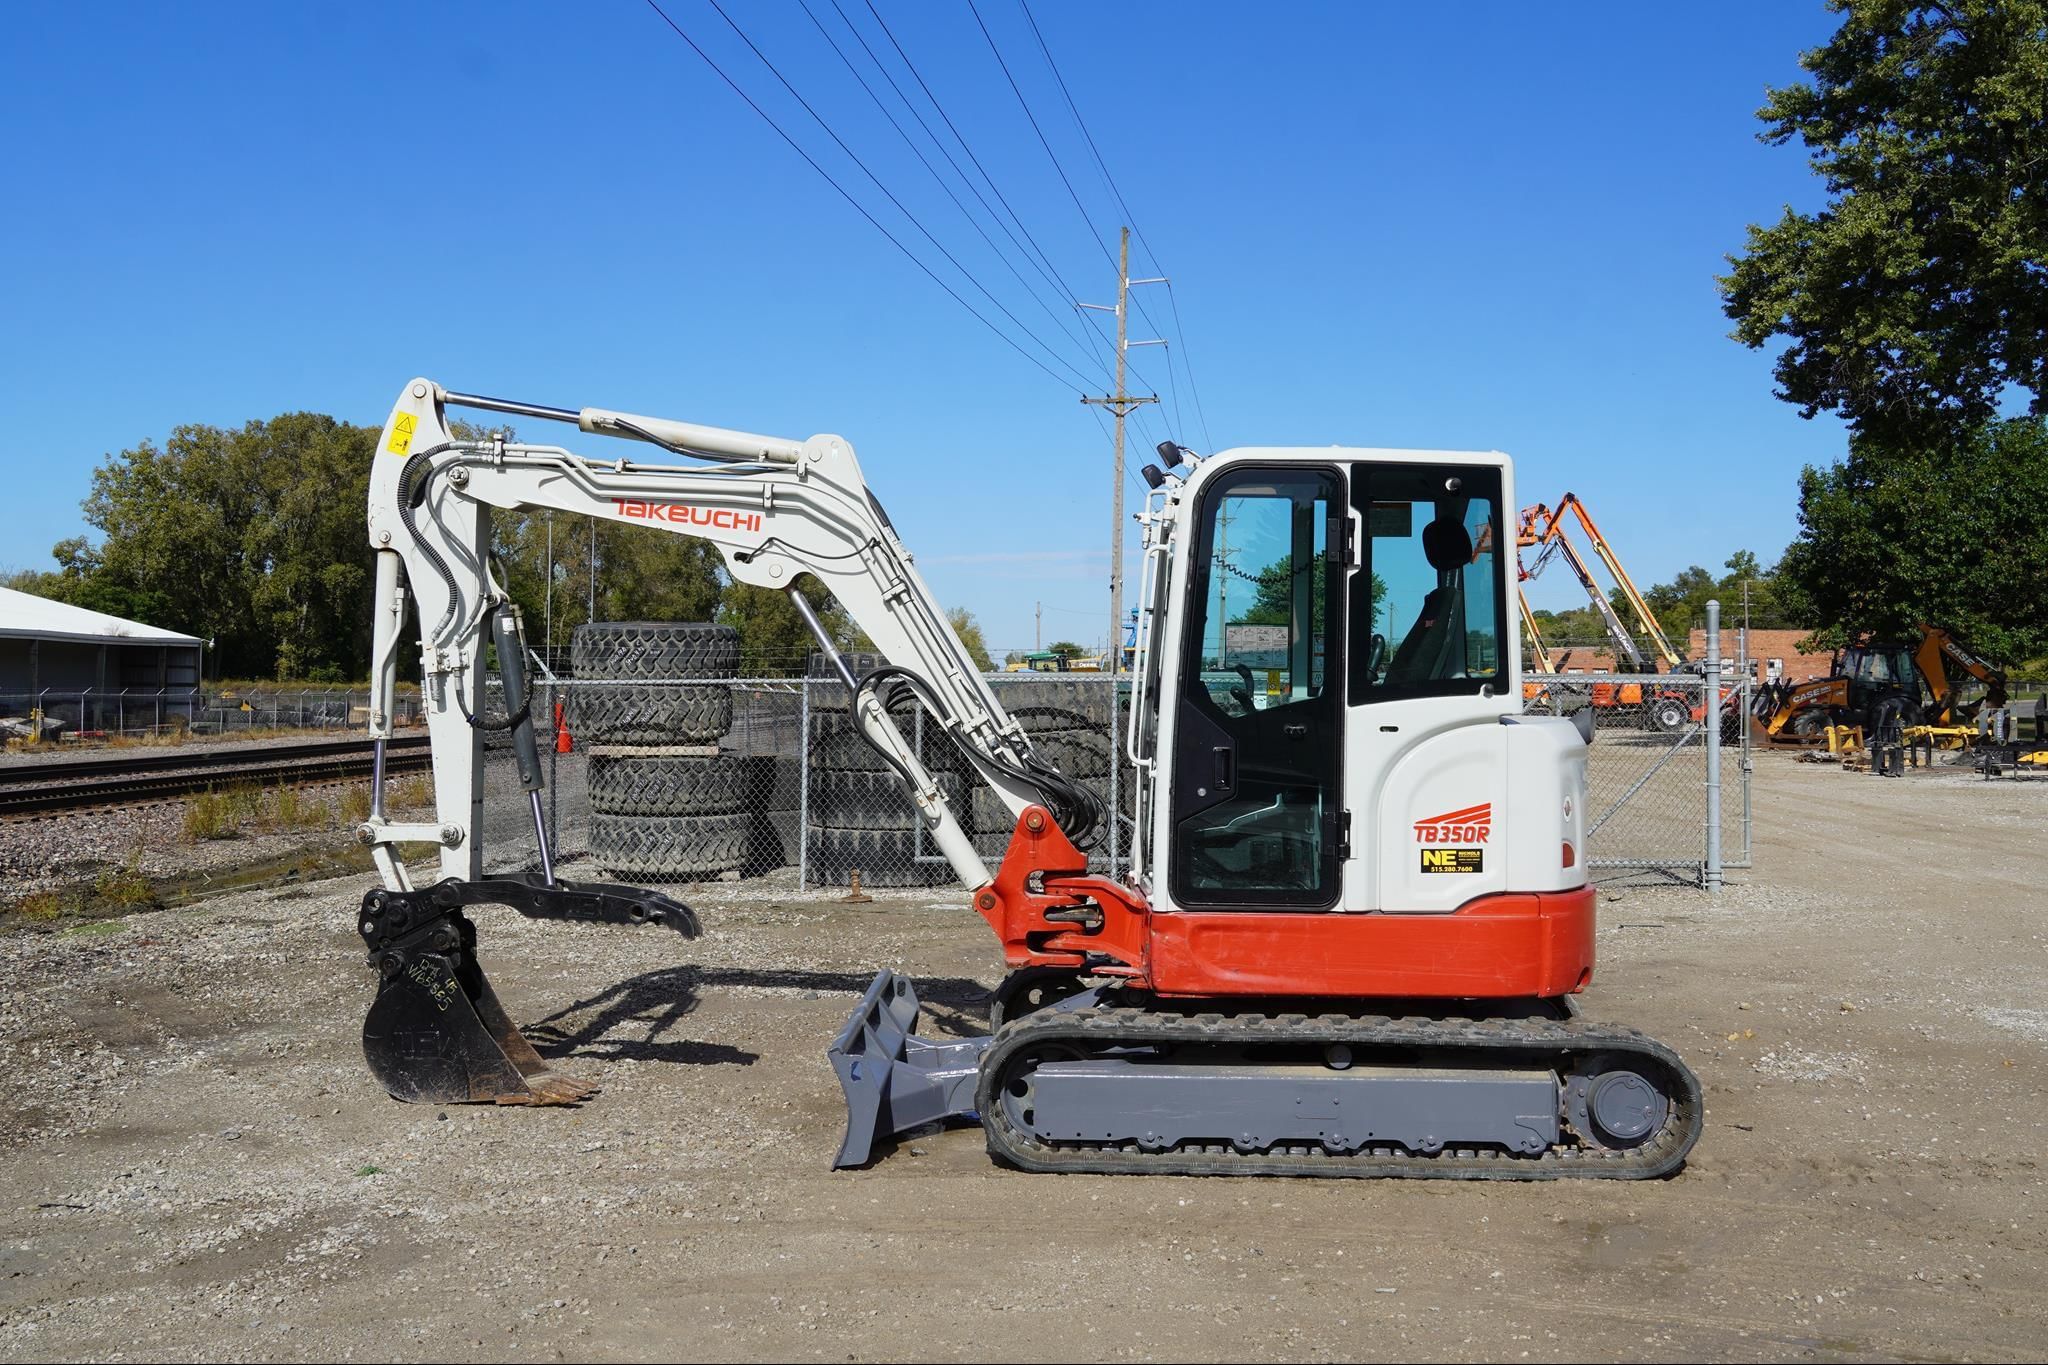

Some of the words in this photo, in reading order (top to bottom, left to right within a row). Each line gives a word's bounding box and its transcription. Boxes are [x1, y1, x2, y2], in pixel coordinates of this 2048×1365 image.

[1946, 642, 1975, 667] CASE
[1792, 688, 1820, 703] CASE
[1413, 825, 1491, 844] TB350R
[1423, 850, 1457, 866] NE
